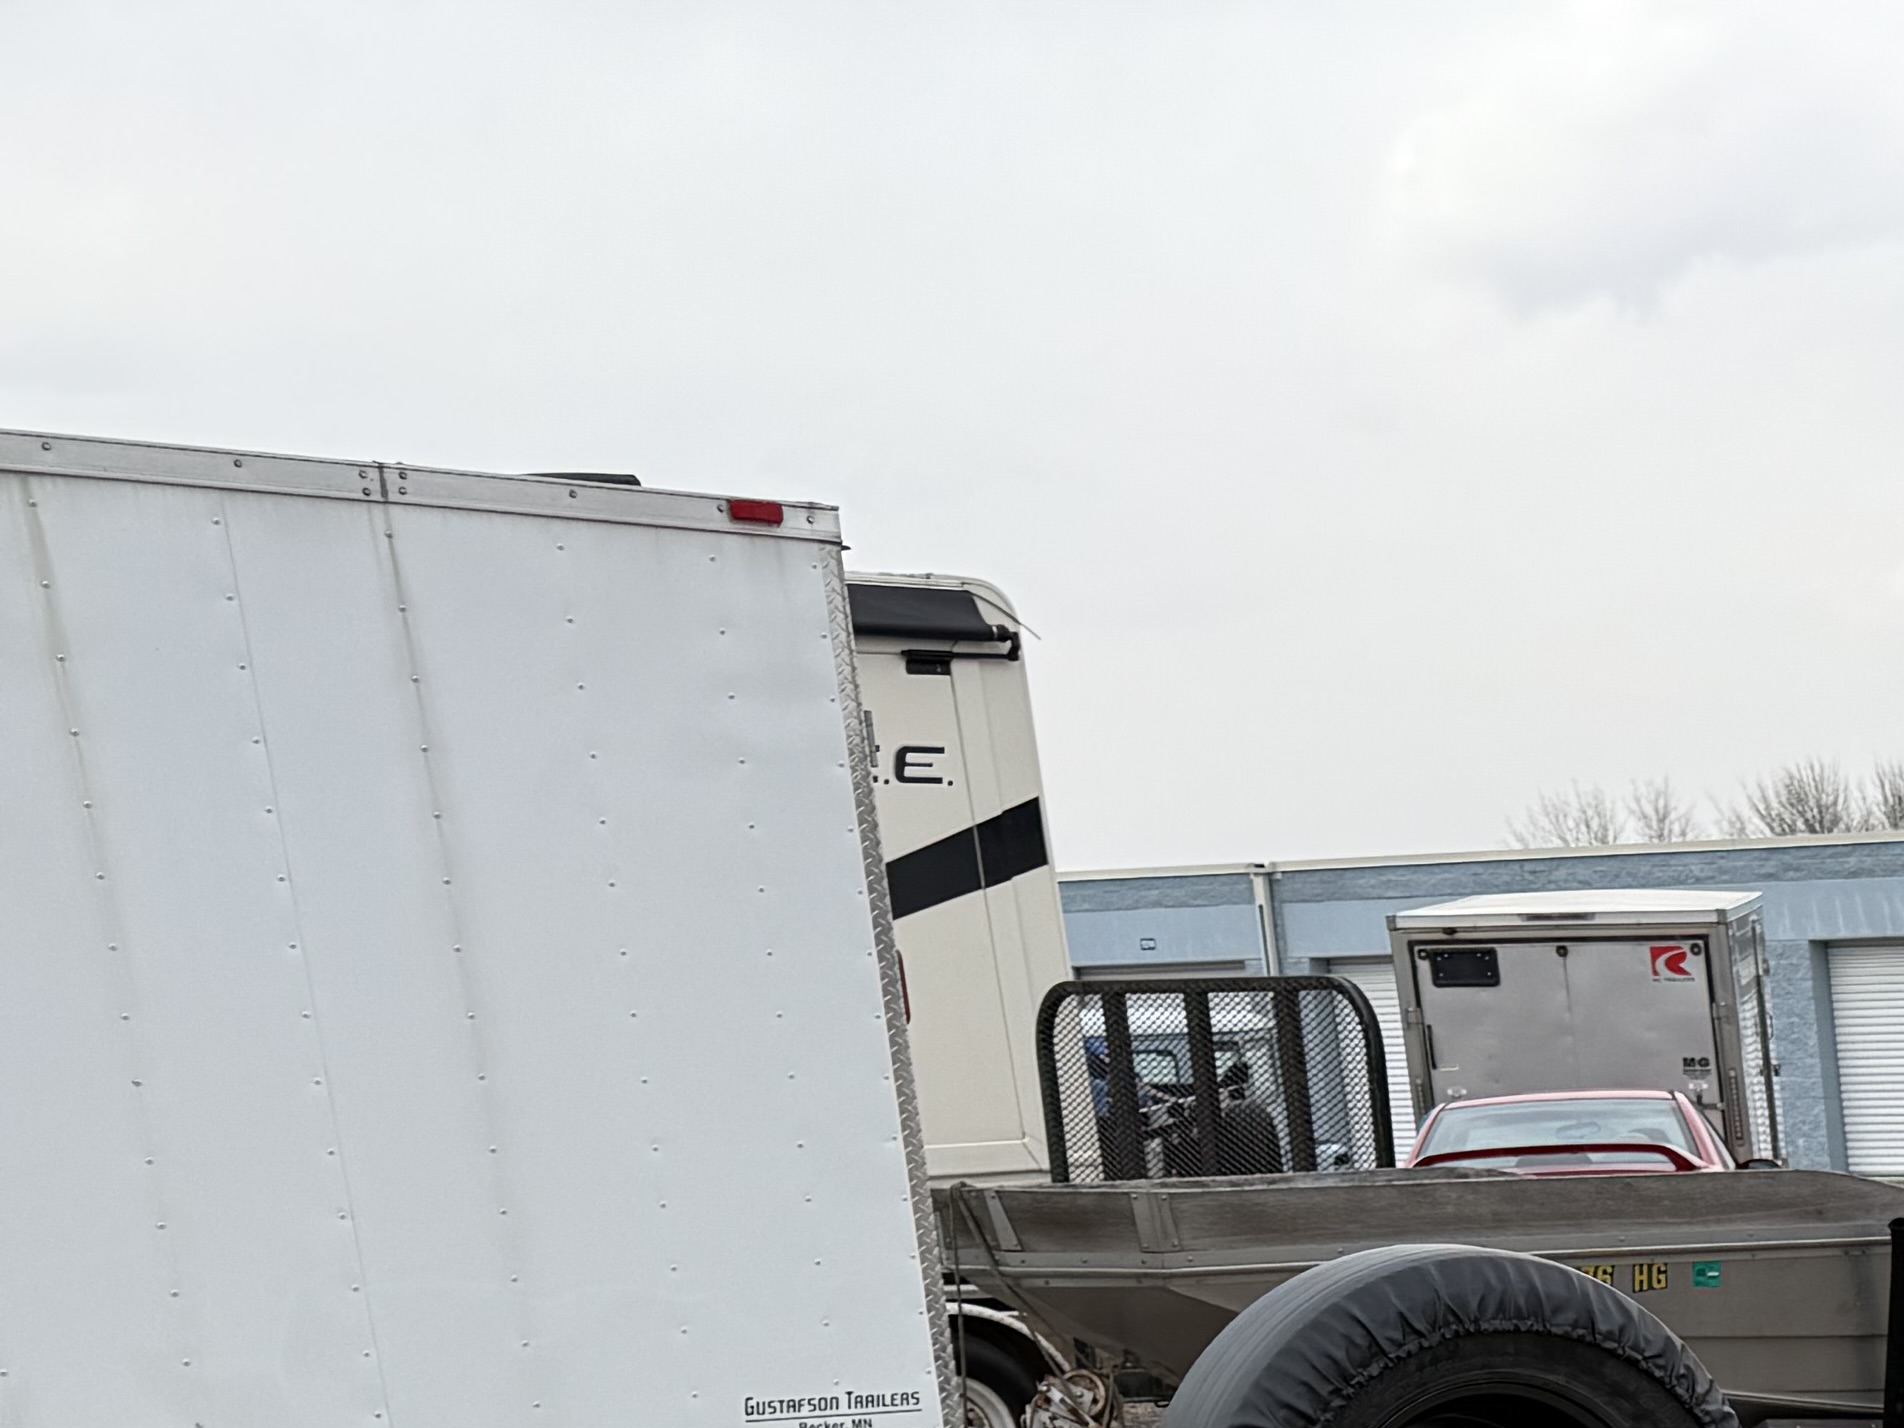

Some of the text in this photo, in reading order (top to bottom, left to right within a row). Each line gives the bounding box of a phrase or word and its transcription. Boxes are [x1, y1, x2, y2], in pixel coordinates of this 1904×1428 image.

[1632, 1262, 1668, 1294] HG
[744, 1390, 920, 1417] GUSTAFSON TRAILERS
